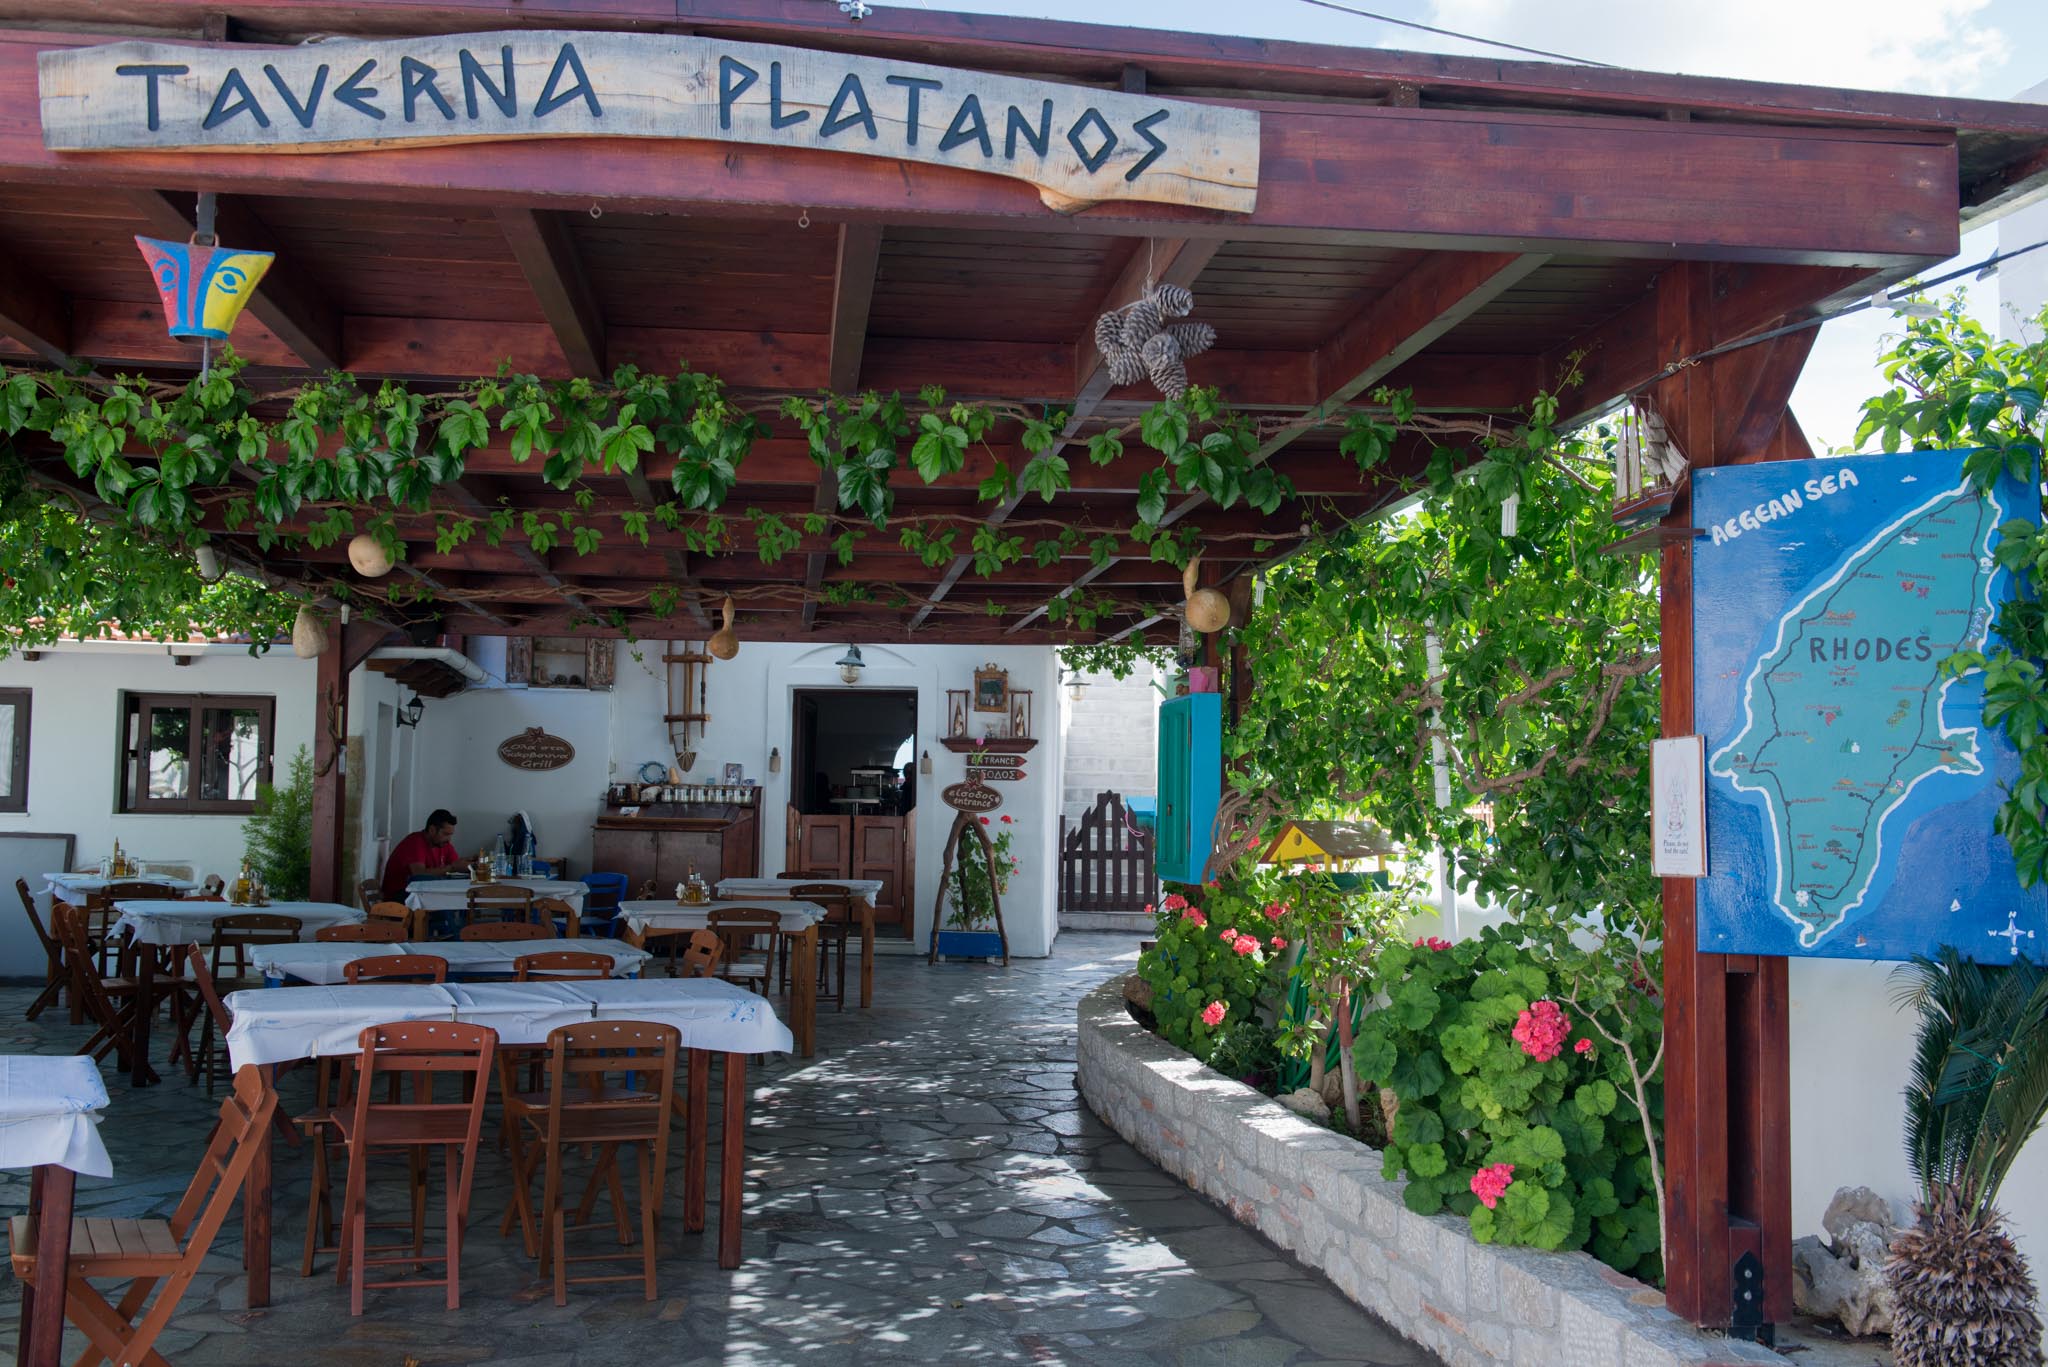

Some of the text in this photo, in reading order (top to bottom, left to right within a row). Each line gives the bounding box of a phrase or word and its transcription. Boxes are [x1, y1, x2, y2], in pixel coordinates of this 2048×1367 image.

[115, 42, 1170, 181] TAVERNA PLATANOS
[1711, 468, 1859, 546] AEGEAN SEA
[1810, 636, 1932, 663] RHODES
[970, 769, 1016, 780] ΣΟΔΟΣ
[2010, 946, 2018, 955] S
